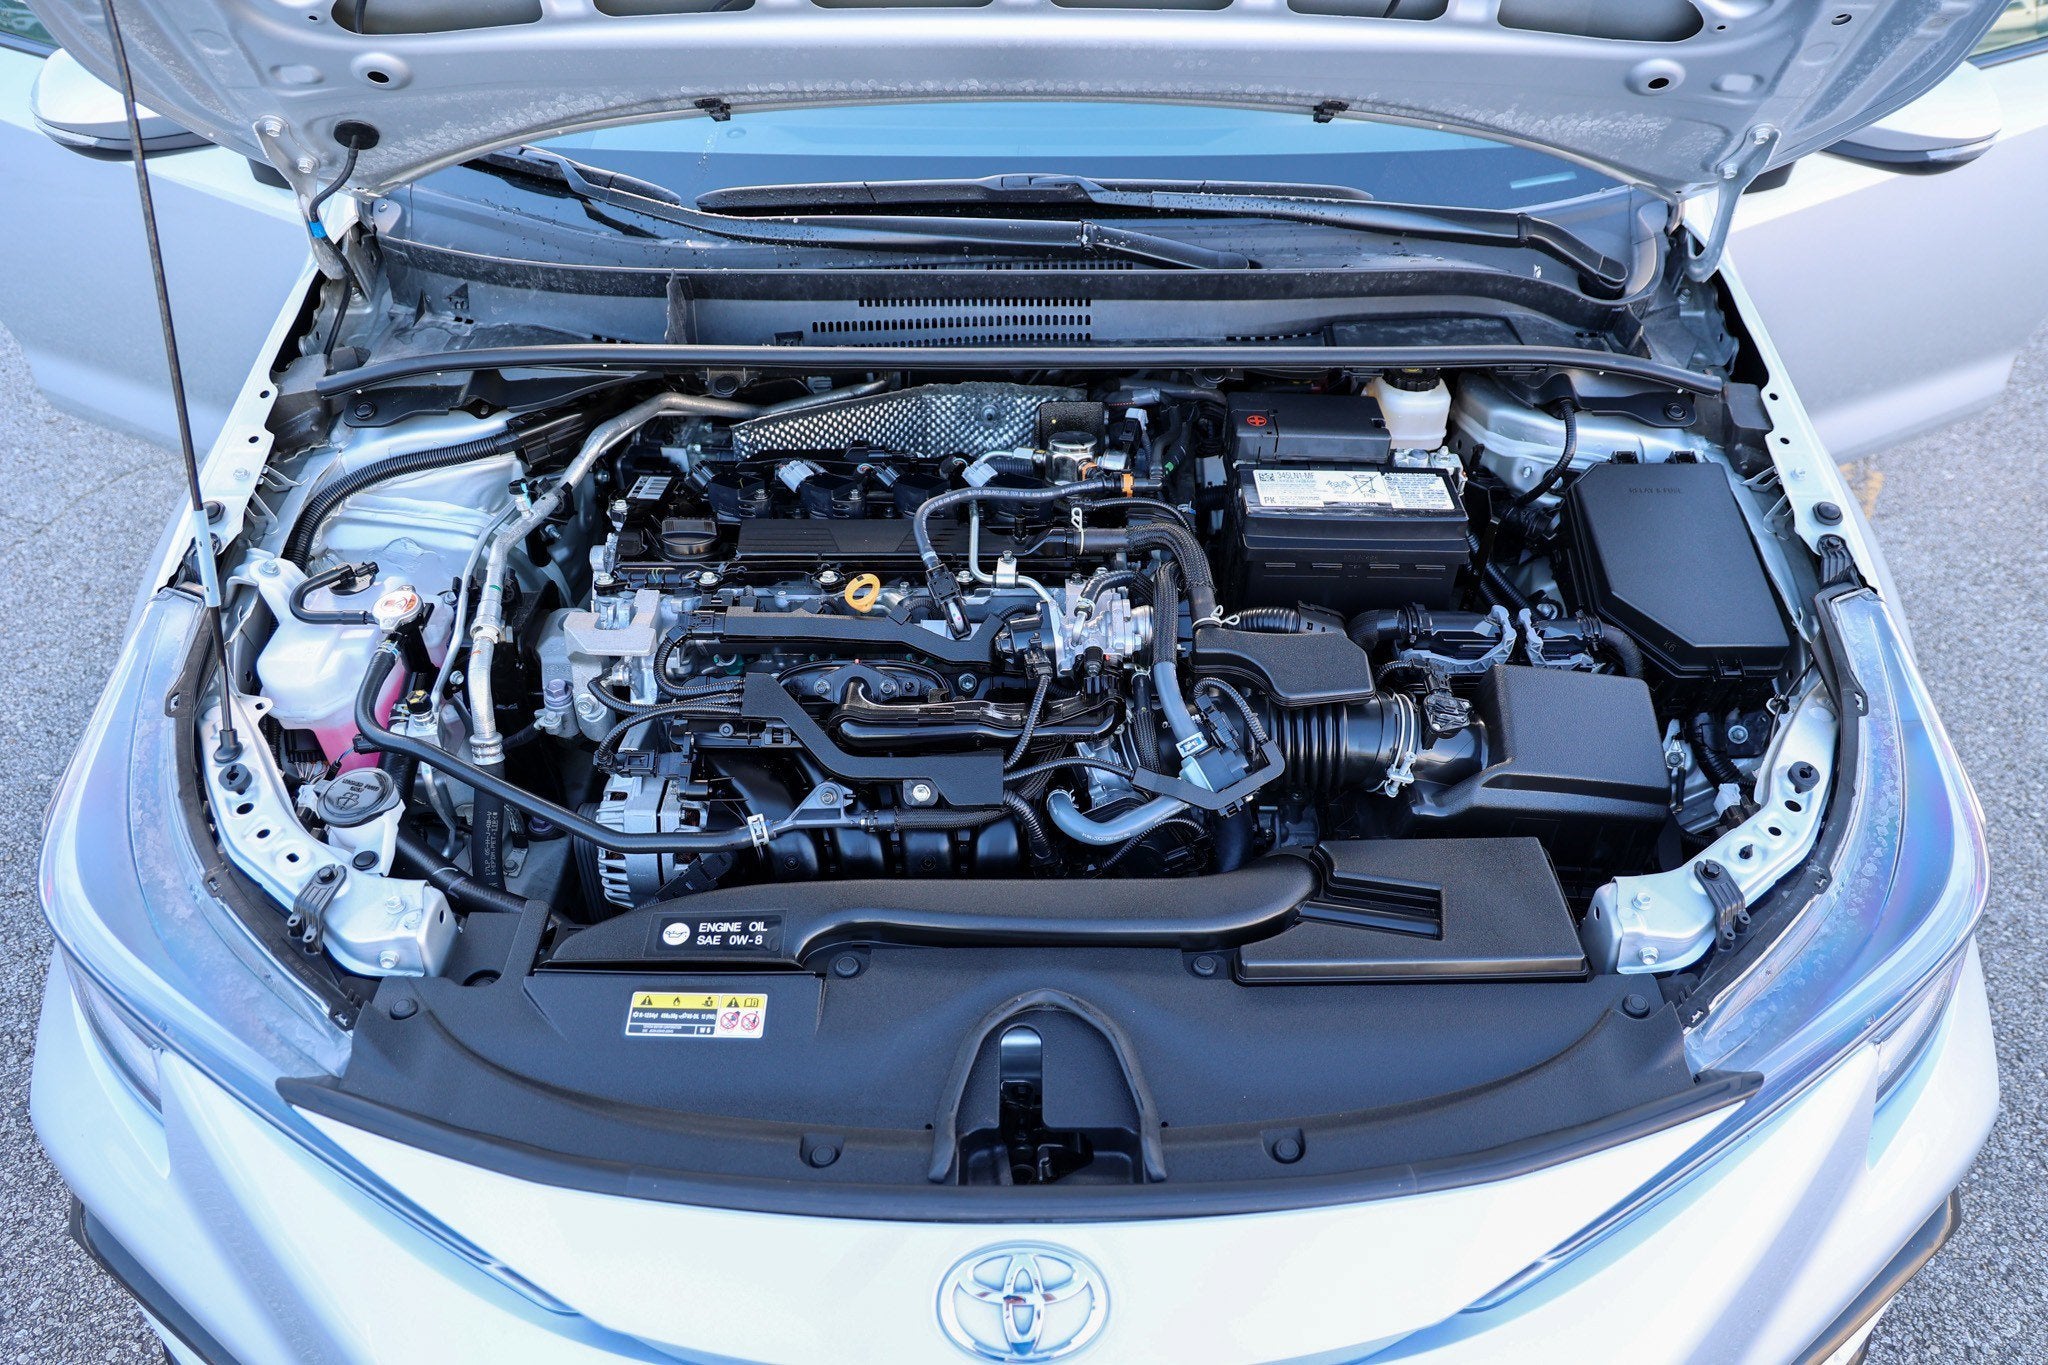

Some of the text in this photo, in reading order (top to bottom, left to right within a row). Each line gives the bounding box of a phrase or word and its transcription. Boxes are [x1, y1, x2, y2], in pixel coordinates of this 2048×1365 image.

[1264, 496, 1276, 504] PK
[698, 921, 768, 932] ENGINE OIL
[696, 935, 721, 945] SAE
